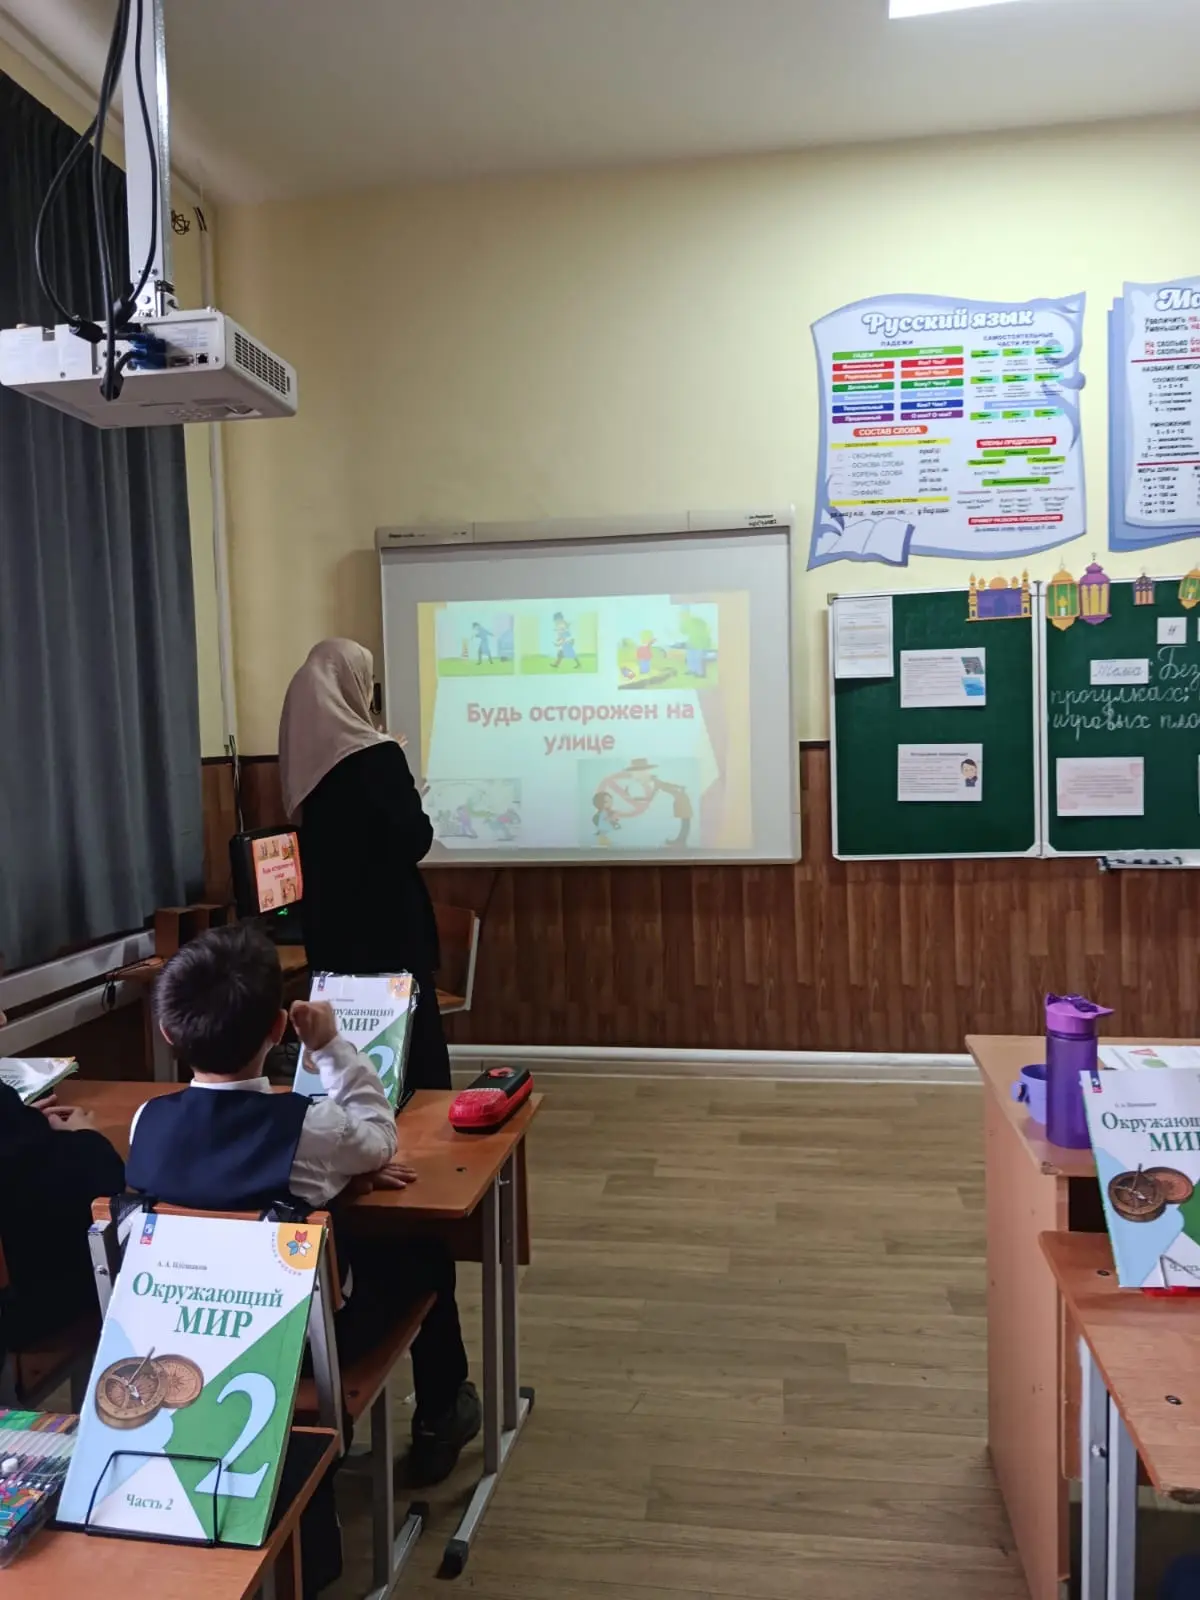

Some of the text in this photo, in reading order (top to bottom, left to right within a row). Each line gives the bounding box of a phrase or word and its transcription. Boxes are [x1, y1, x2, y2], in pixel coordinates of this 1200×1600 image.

[862, 308, 1034, 338] Русский язык
[859, 428, 892, 436] СОСТАВ
[467, 702, 695, 727] Будь осторожен на
[544, 734, 615, 755] улице
[340, 1018, 379, 1032] МИР
[132, 1271, 284, 1309] Окружающий
[174, 1305, 253, 1339] МИР
[194, 1372, 277, 1498] 2
[126, 1493, 174, 1511] Часть 2
